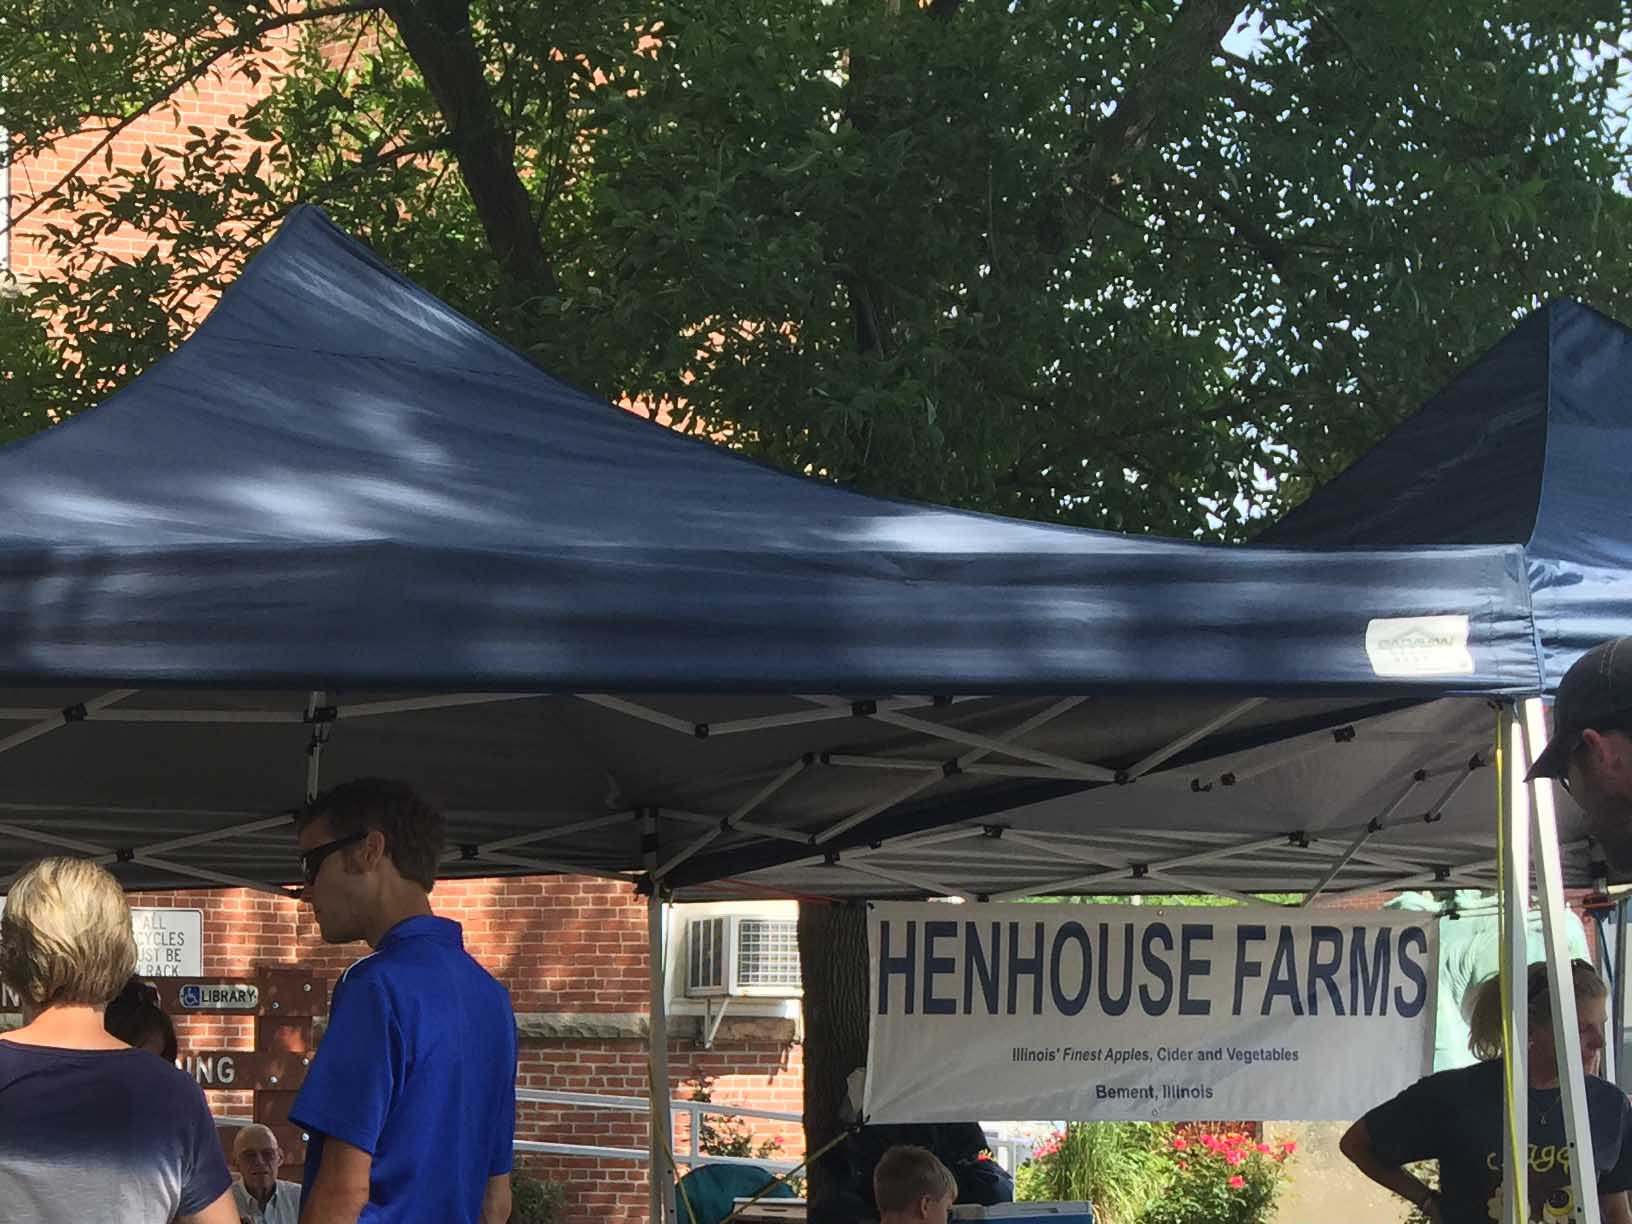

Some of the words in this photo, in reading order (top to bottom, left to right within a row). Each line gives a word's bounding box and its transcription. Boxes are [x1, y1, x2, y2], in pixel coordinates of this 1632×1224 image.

[143, 912, 167, 930] ALL
[135, 931, 185, 946] CYCLES
[138, 948, 159, 962] UST
[166, 948, 182, 962] BE
[878, 920, 1214, 1016] HENHOUSE
[1232, 924, 1427, 1018] FARMS
[201, 989, 255, 1003] LIBRARY
[1012, 1047, 1060, 1061] Illinois'
[1063, 1047, 1103, 1061] Finest
[1104, 1047, 1153, 1064] Apples,
[1157, 1047, 1192, 1061] Cider
[1197, 1047, 1223, 1061] and
[1226, 1047, 1299, 1064] Vegetables
[1095, 1084, 1158, 1101] Bement,
[1162, 1084, 1214, 1099] Illinois
